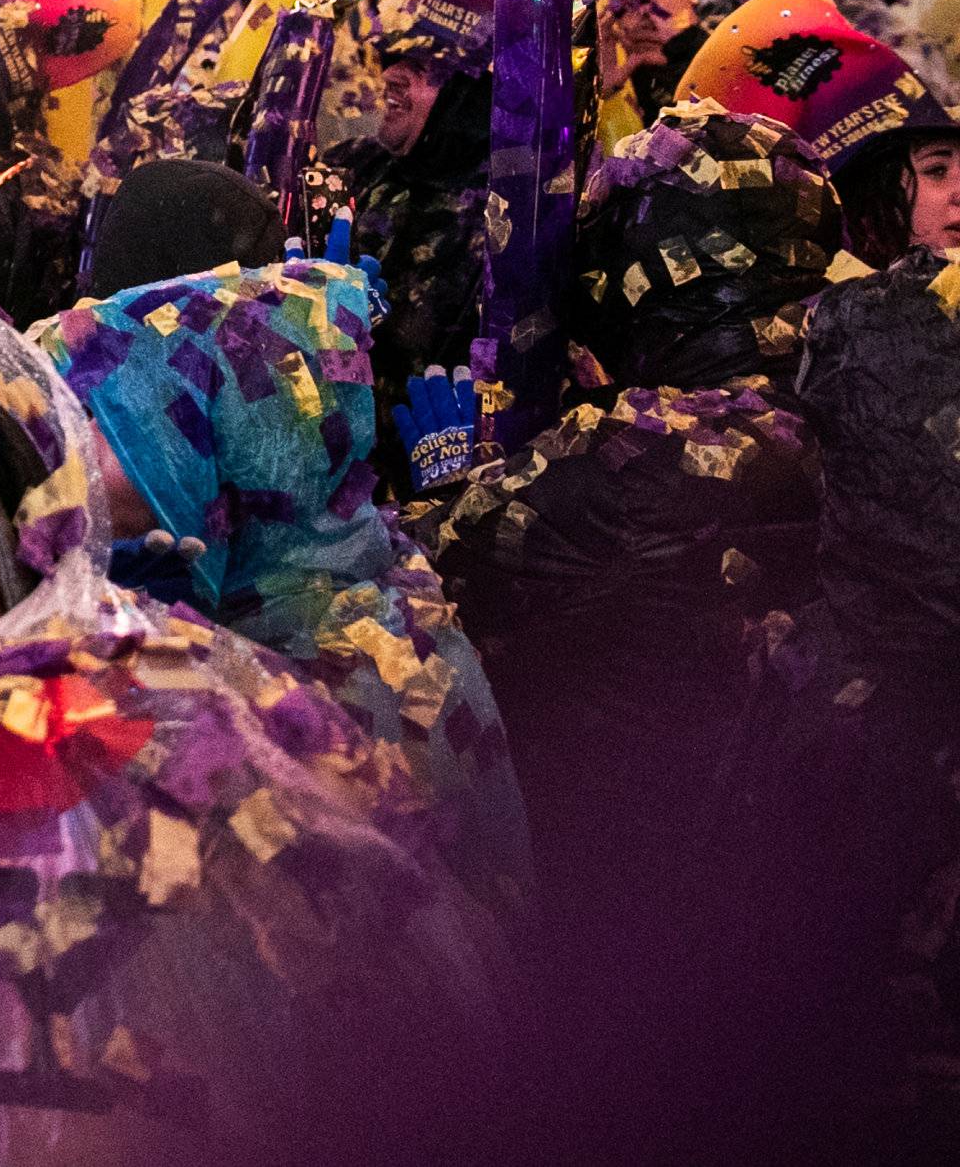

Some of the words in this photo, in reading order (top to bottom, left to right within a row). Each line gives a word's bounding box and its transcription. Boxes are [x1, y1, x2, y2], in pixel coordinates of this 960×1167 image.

[775, 47, 818, 92] planet
[790, 48, 840, 92] fitness
[828, 106, 876, 138] YEAR'S
[411, 431, 468, 463] Believe
